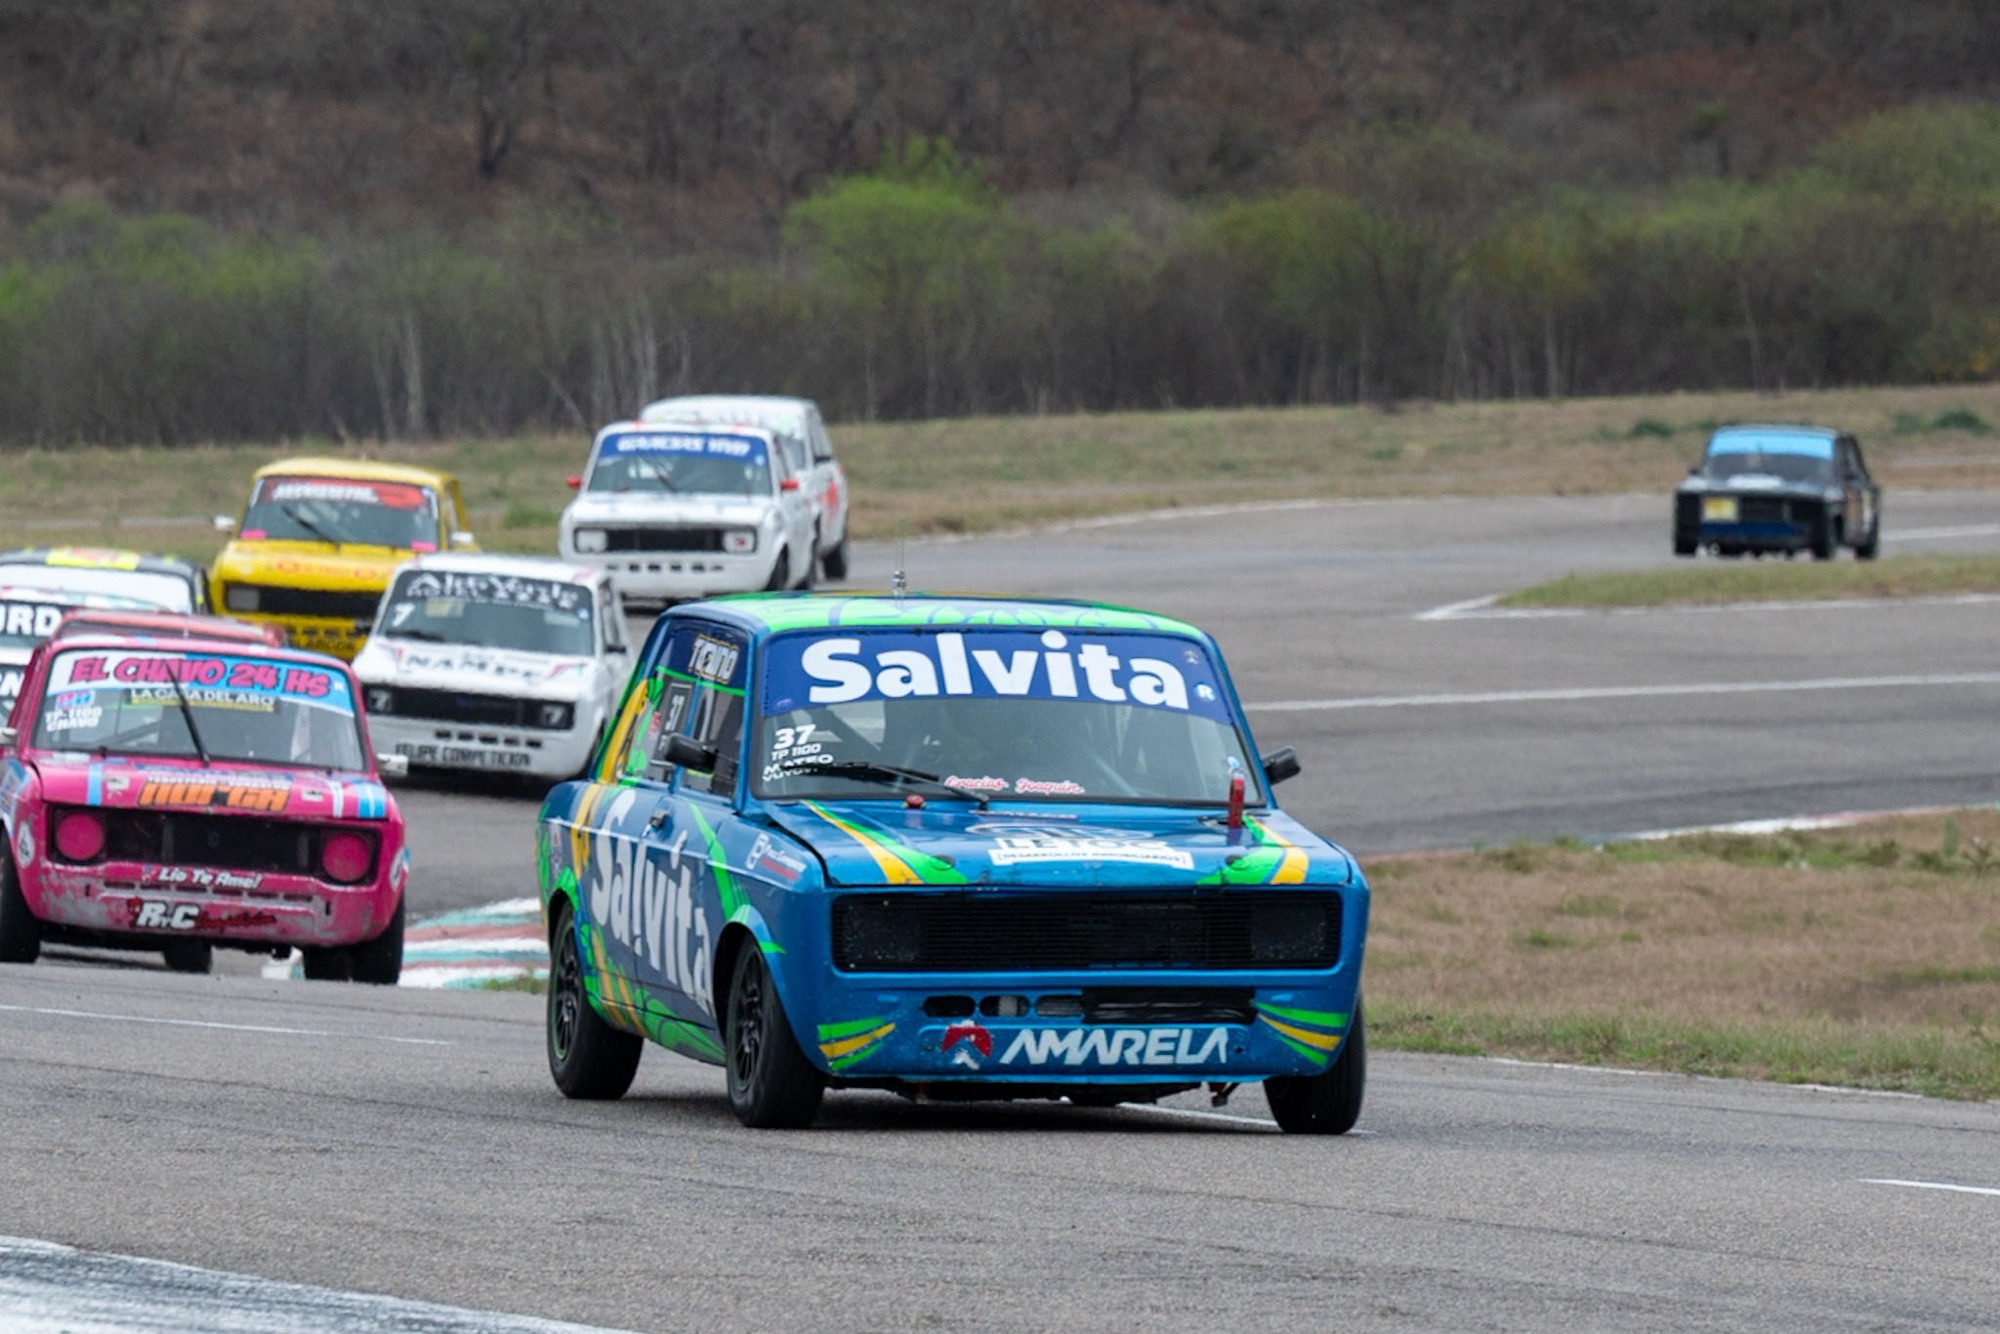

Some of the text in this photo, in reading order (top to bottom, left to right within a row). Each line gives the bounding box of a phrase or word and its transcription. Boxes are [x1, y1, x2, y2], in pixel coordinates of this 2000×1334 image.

[392, 602, 415, 626] 7
[69, 657, 332, 698] EL CHAVO 24 HS
[801, 630, 1189, 710] Salvita
[203, 690, 234, 702] DEL
[773, 723, 816, 750] 37
[763, 754, 834, 776] MATEO
[771, 743, 822, 761] TP 1100
[591, 789, 716, 1018] Salvita
[999, 1027, 1228, 1065] AMARELA
